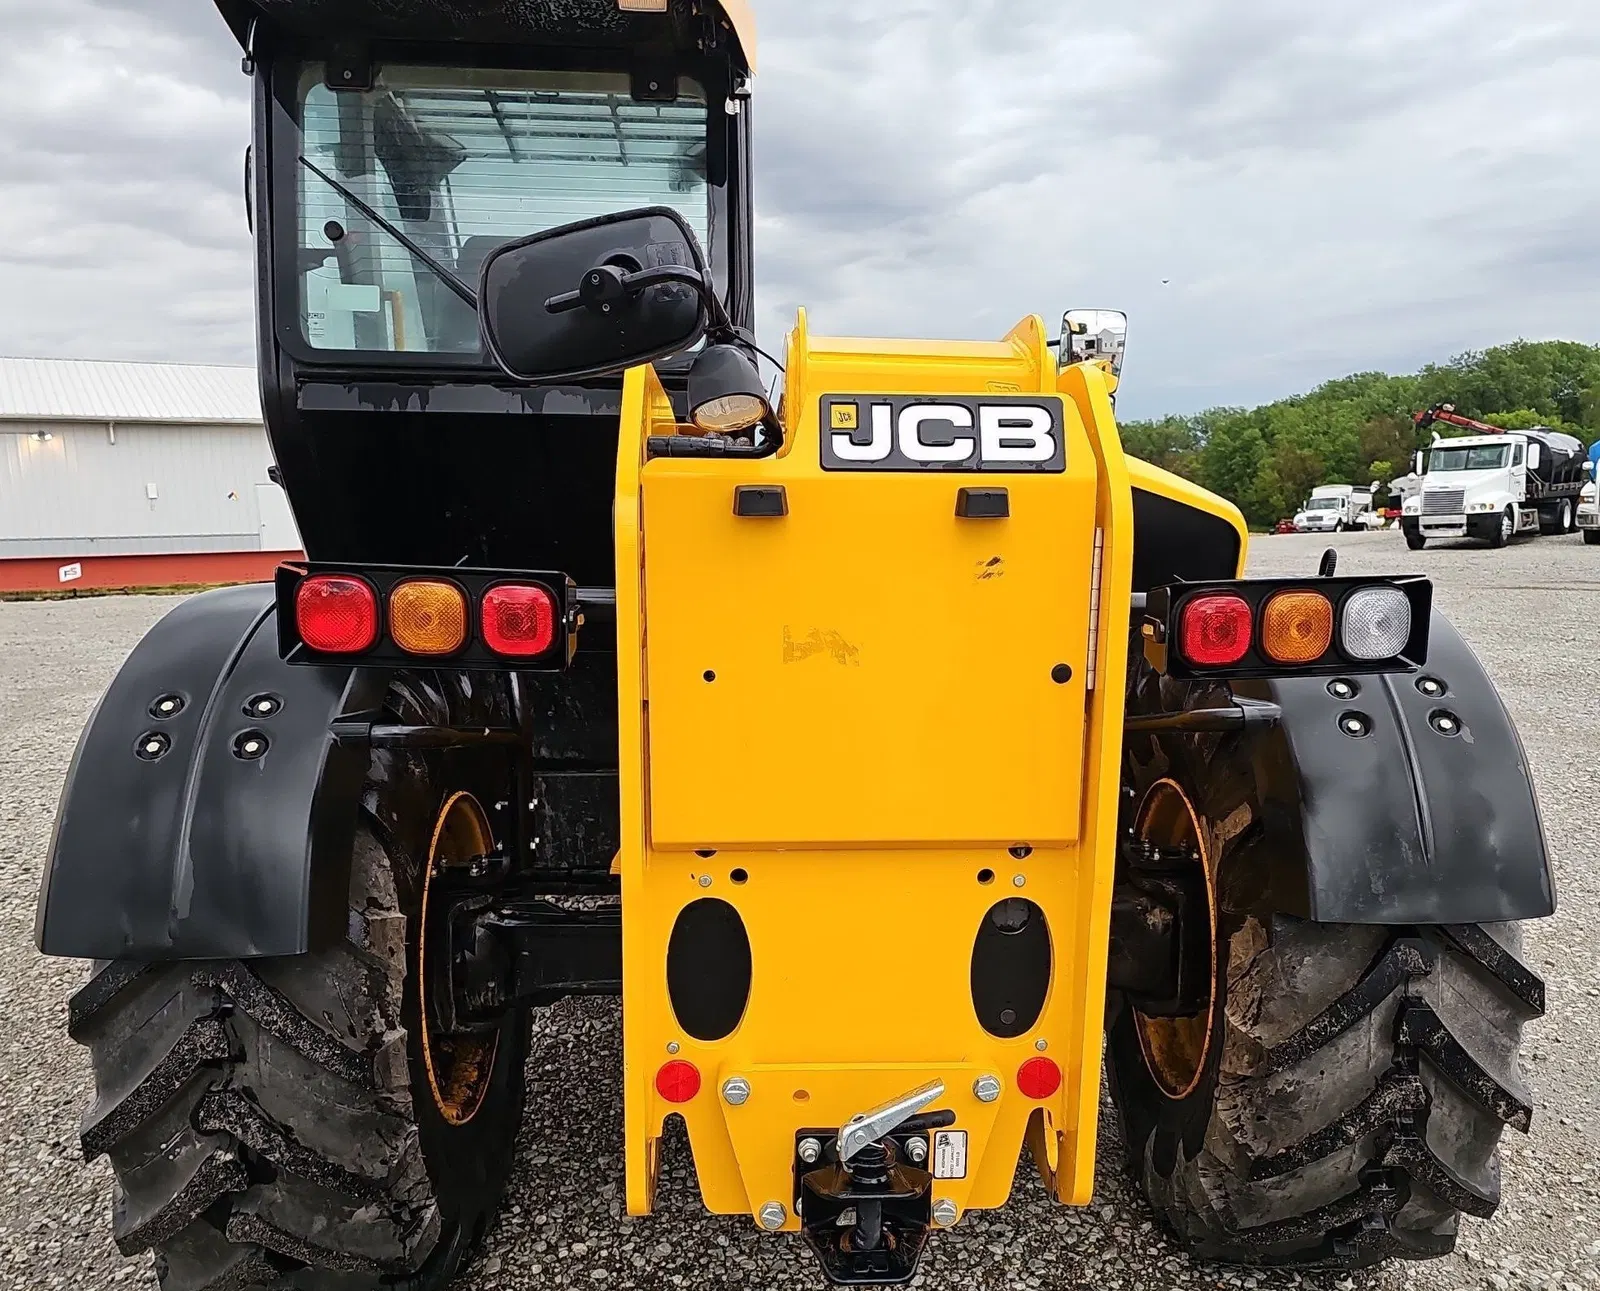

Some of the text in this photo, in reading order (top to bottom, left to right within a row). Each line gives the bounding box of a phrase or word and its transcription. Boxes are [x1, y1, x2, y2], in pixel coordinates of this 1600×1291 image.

[838, 411, 852, 423] JCB
[830, 403, 1056, 462] JCB
[63, 567, 78, 578] FS
[937, 1133, 950, 1147] JCB
